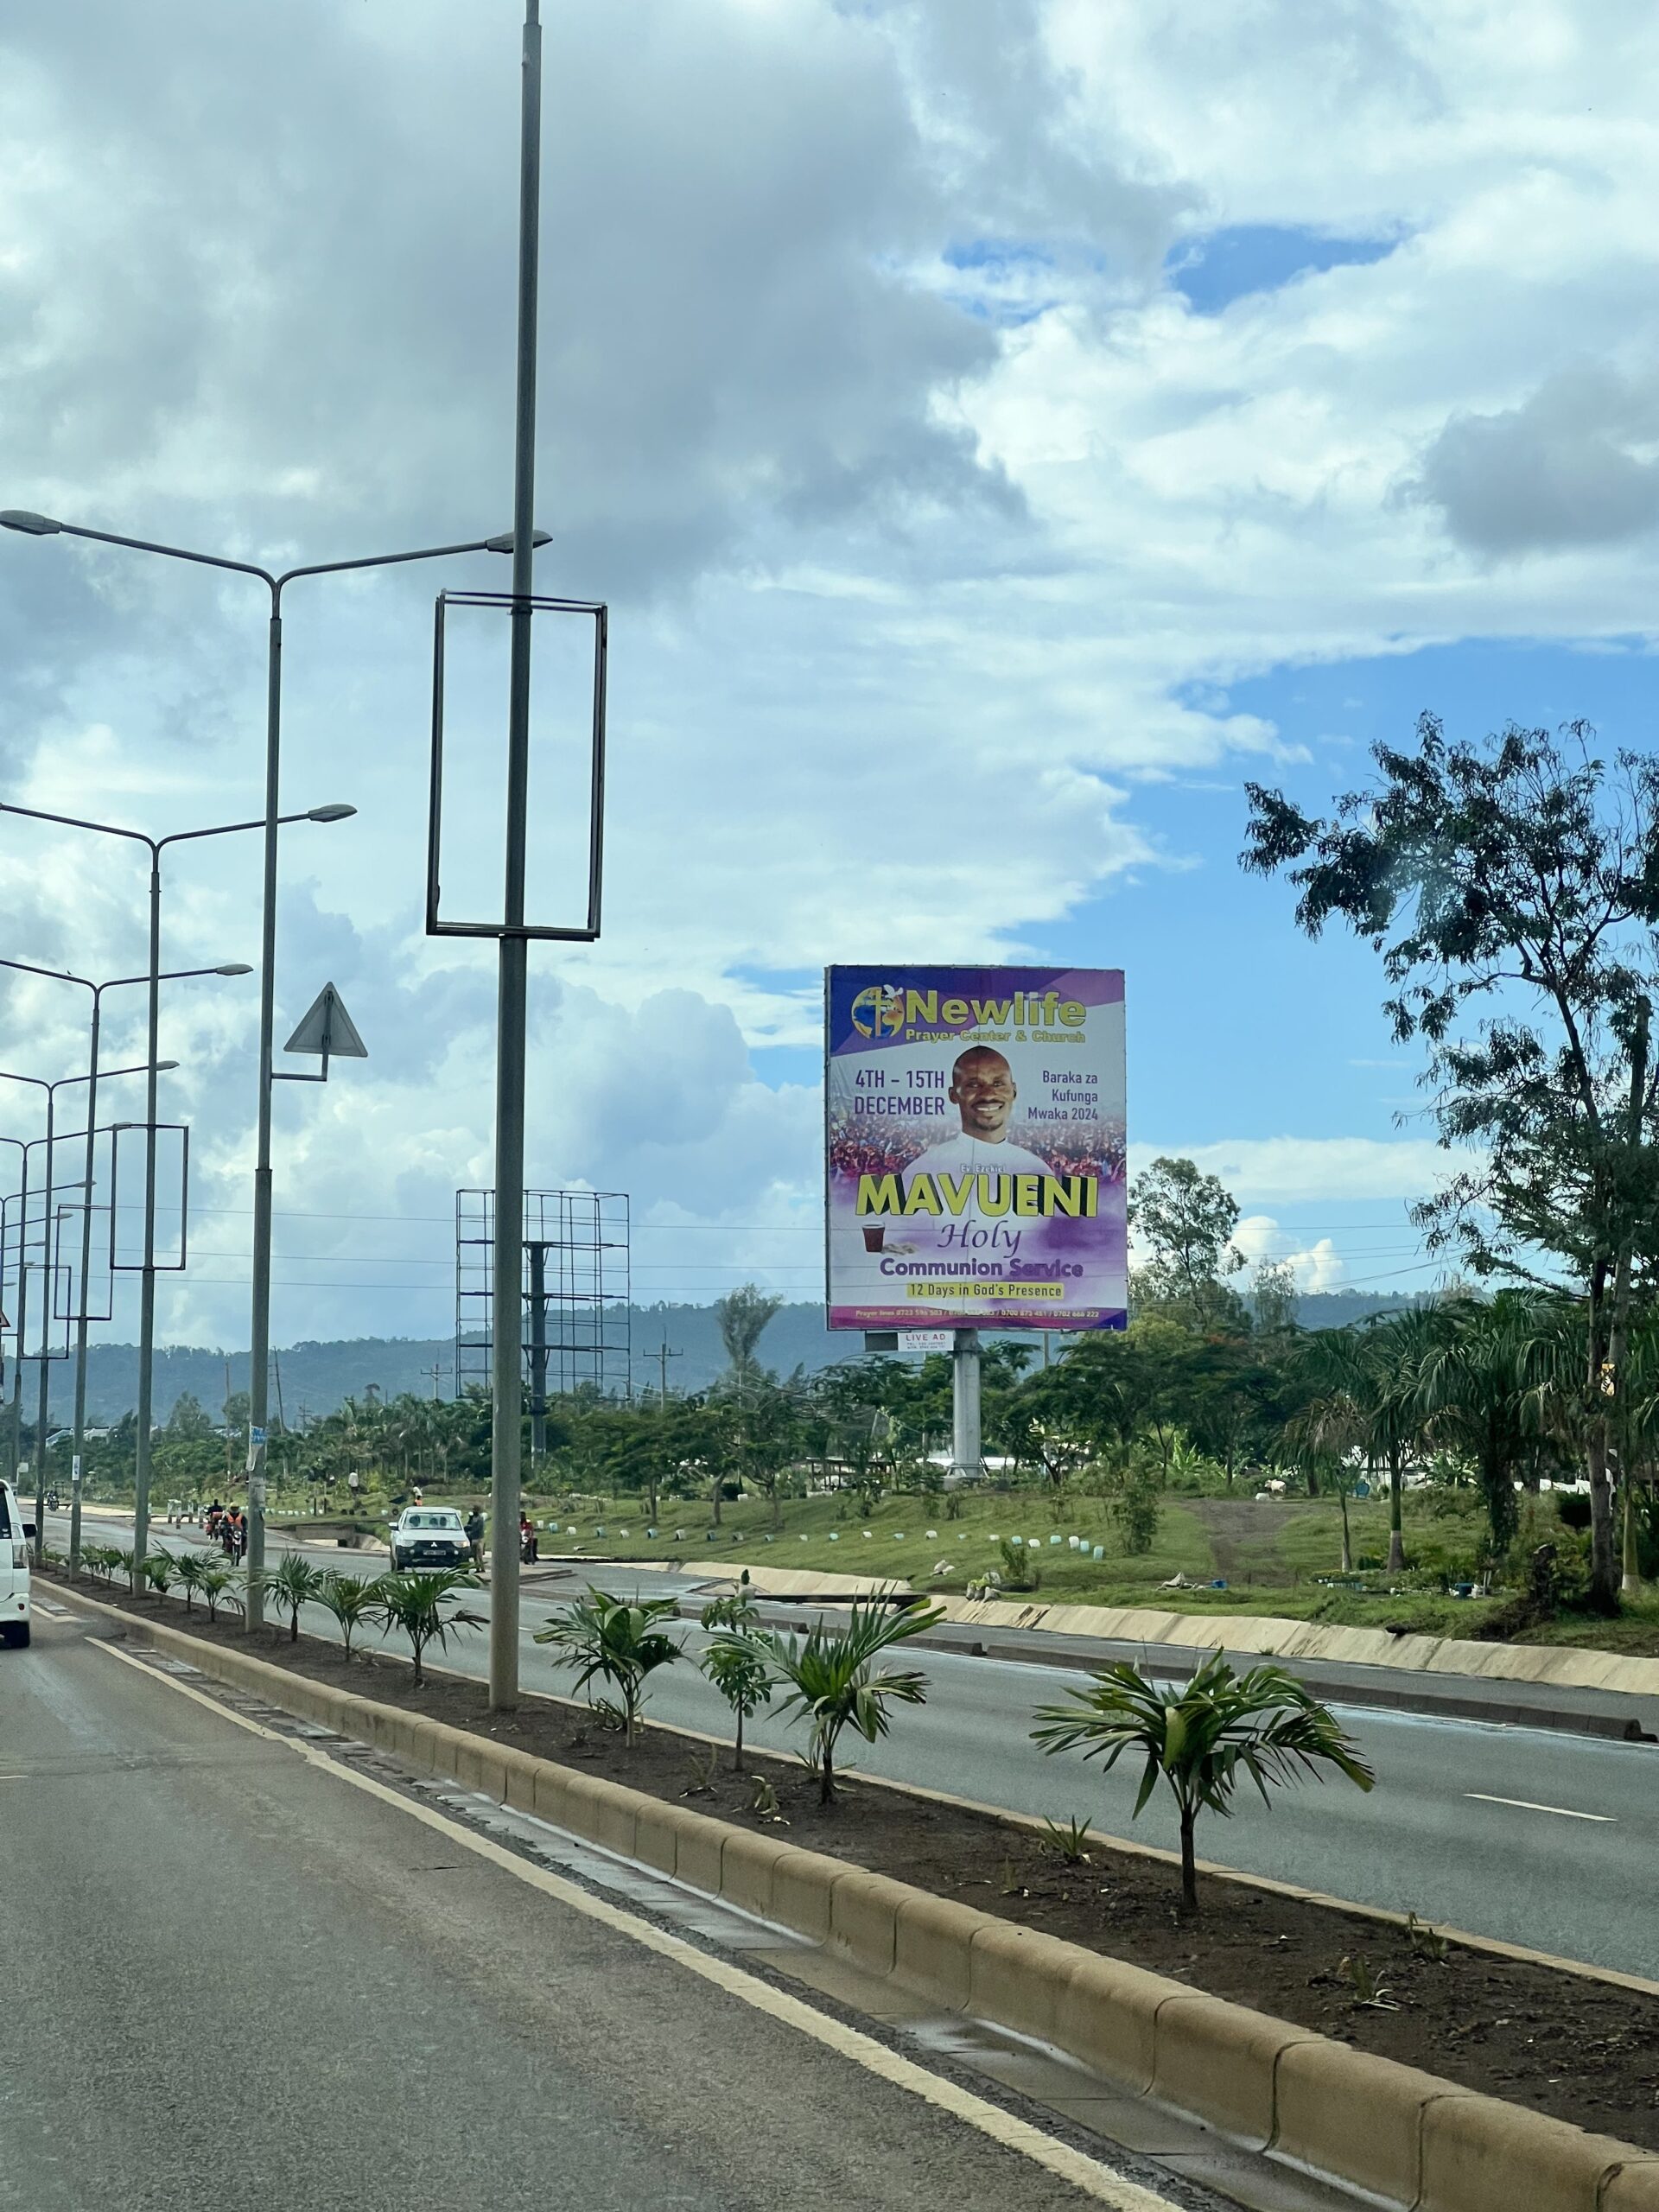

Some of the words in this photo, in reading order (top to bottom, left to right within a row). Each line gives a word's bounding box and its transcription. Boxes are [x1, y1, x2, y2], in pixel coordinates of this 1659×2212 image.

[906, 989, 1087, 1027] Newlife
[906, 1029, 956, 1044] Prayer
[960, 1029, 1012, 1042] Center
[1015, 1030, 1027, 1042] &
[1032, 1030, 1086, 1043] Church
[855, 1070, 885, 1088] 4TH
[906, 1071, 945, 1089] 15TH
[1042, 1071, 1082, 1084] Baraka
[1084, 1074, 1098, 1084] za
[854, 1096, 945, 1116] DECEMBER
[1052, 1089, 1098, 1104] Kufunga
[1027, 1107, 1068, 1121] Mwaka
[1071, 1108, 1098, 1121] 2024
[855, 1173, 1099, 1217] MAVUENI
[937, 1219, 1022, 1259] Holy
[880, 1258, 1003, 1276] Communion
[1009, 1258, 1084, 1277] Service
[911, 1283, 924, 1295] 12
[928, 1284, 955, 1298] Days
[959, 1284, 969, 1295] in
[974, 1284, 1004, 1296] God's
[1008, 1284, 1062, 1297] Presence
